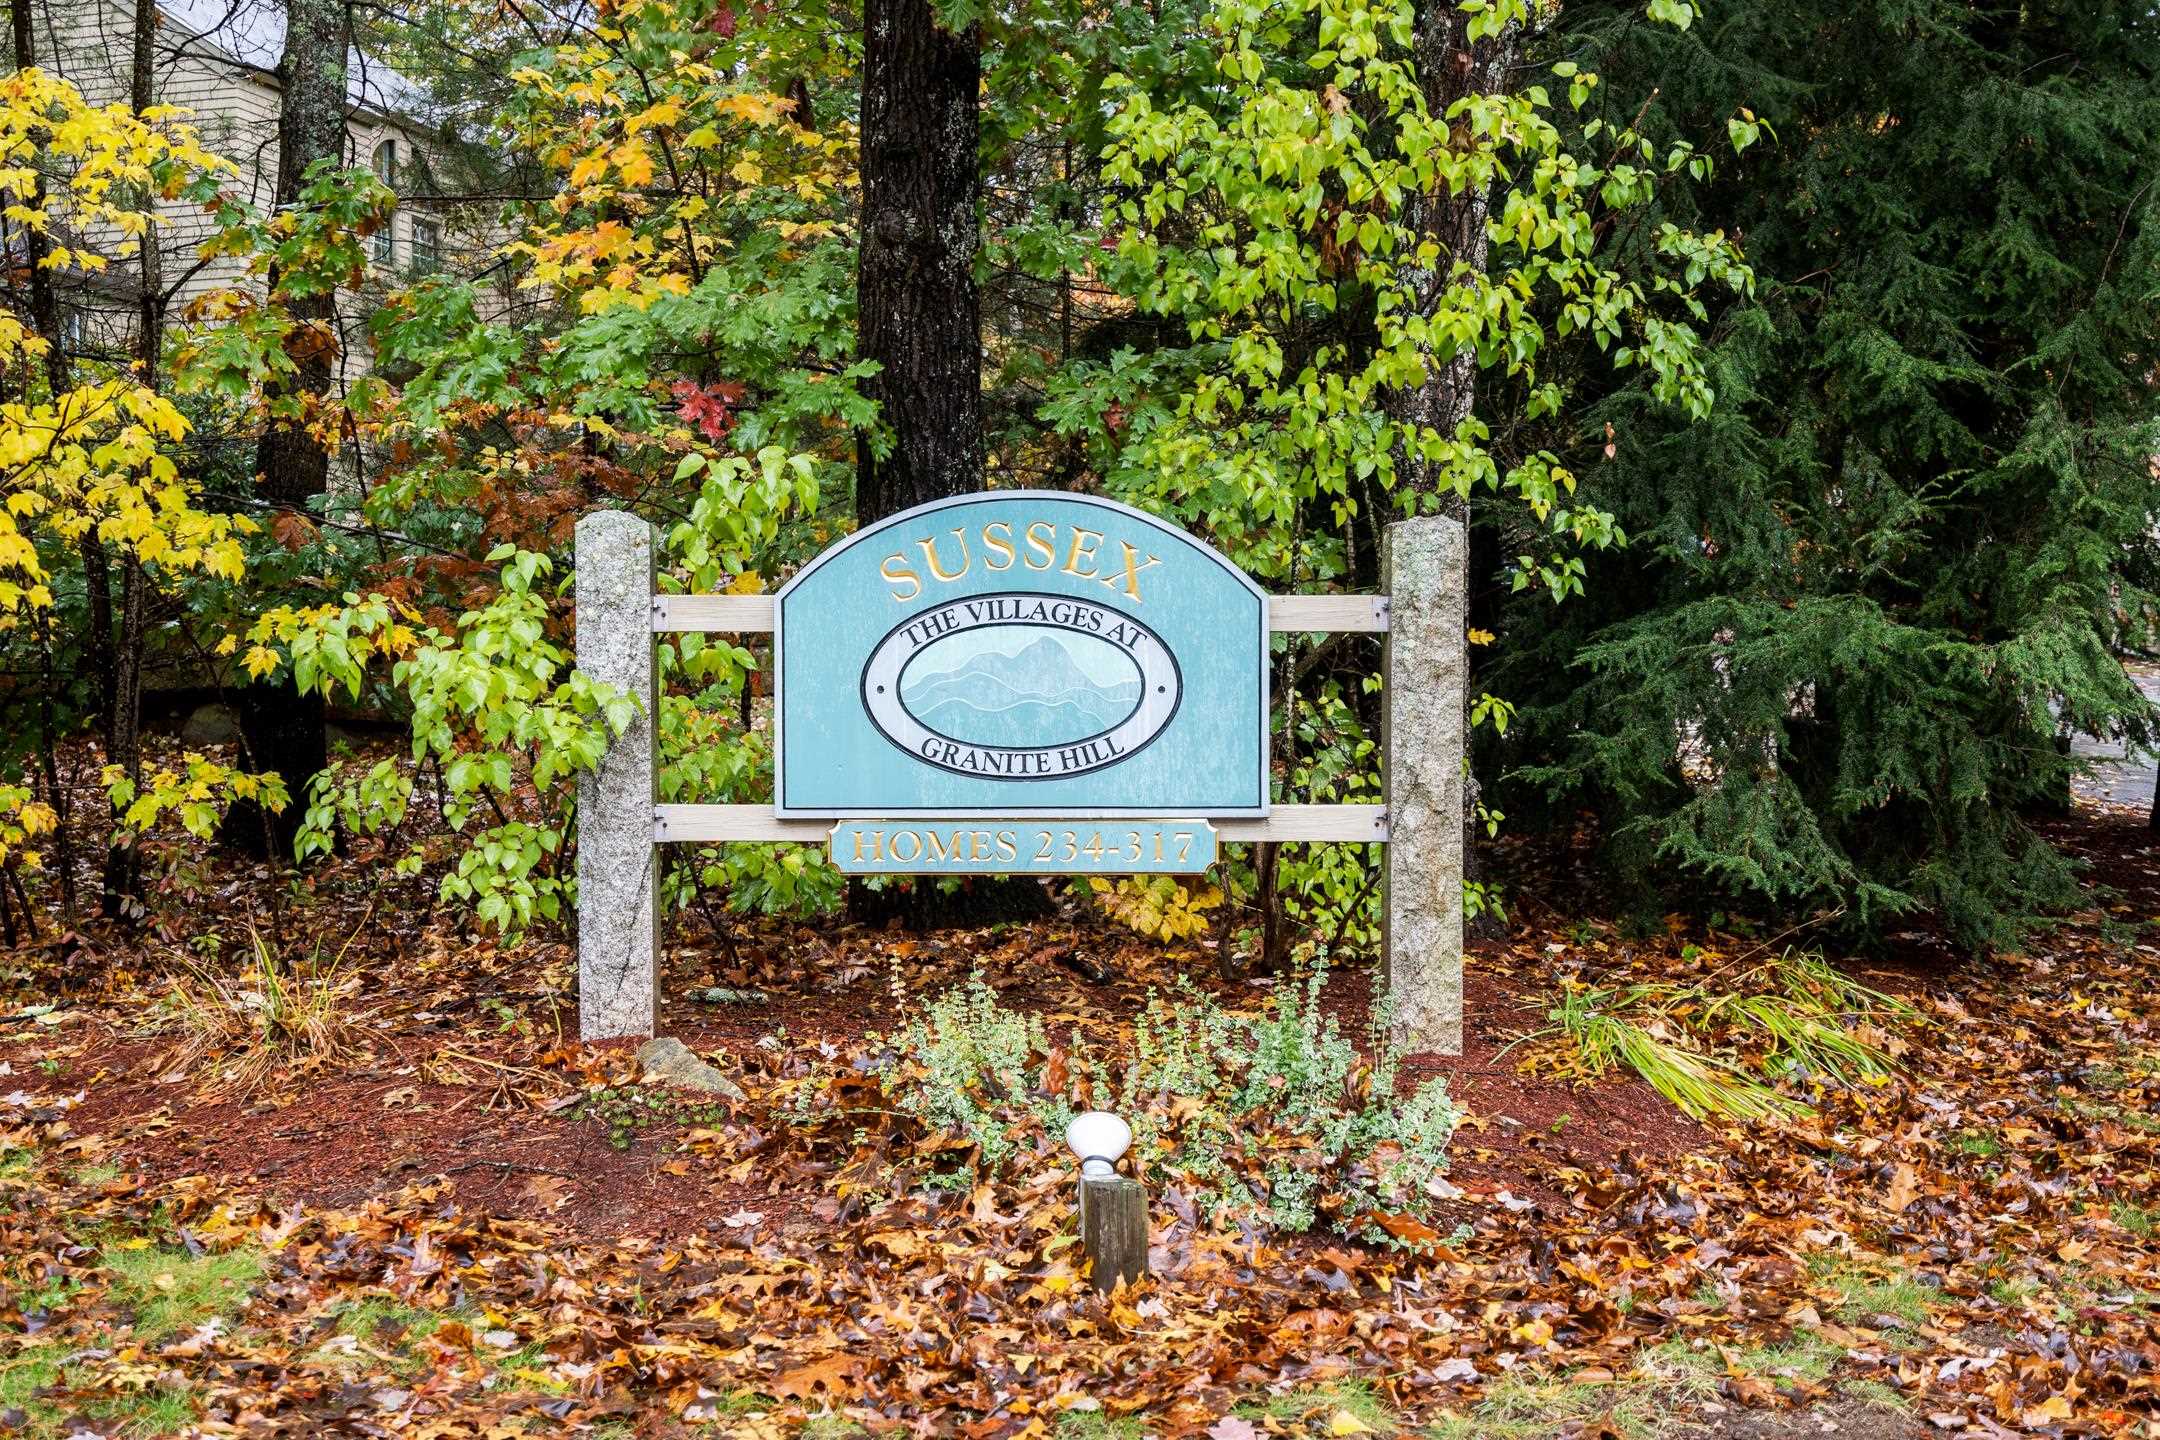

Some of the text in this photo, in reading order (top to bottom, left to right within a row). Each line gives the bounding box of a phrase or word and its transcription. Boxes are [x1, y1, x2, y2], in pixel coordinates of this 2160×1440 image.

[879, 521, 1162, 603] SUSSEX
[899, 599, 1148, 651] THE VILLAGES AT
[920, 736, 1125, 773] GRANITE HILL
[852, 830, 1194, 863] HOMES 234-317
